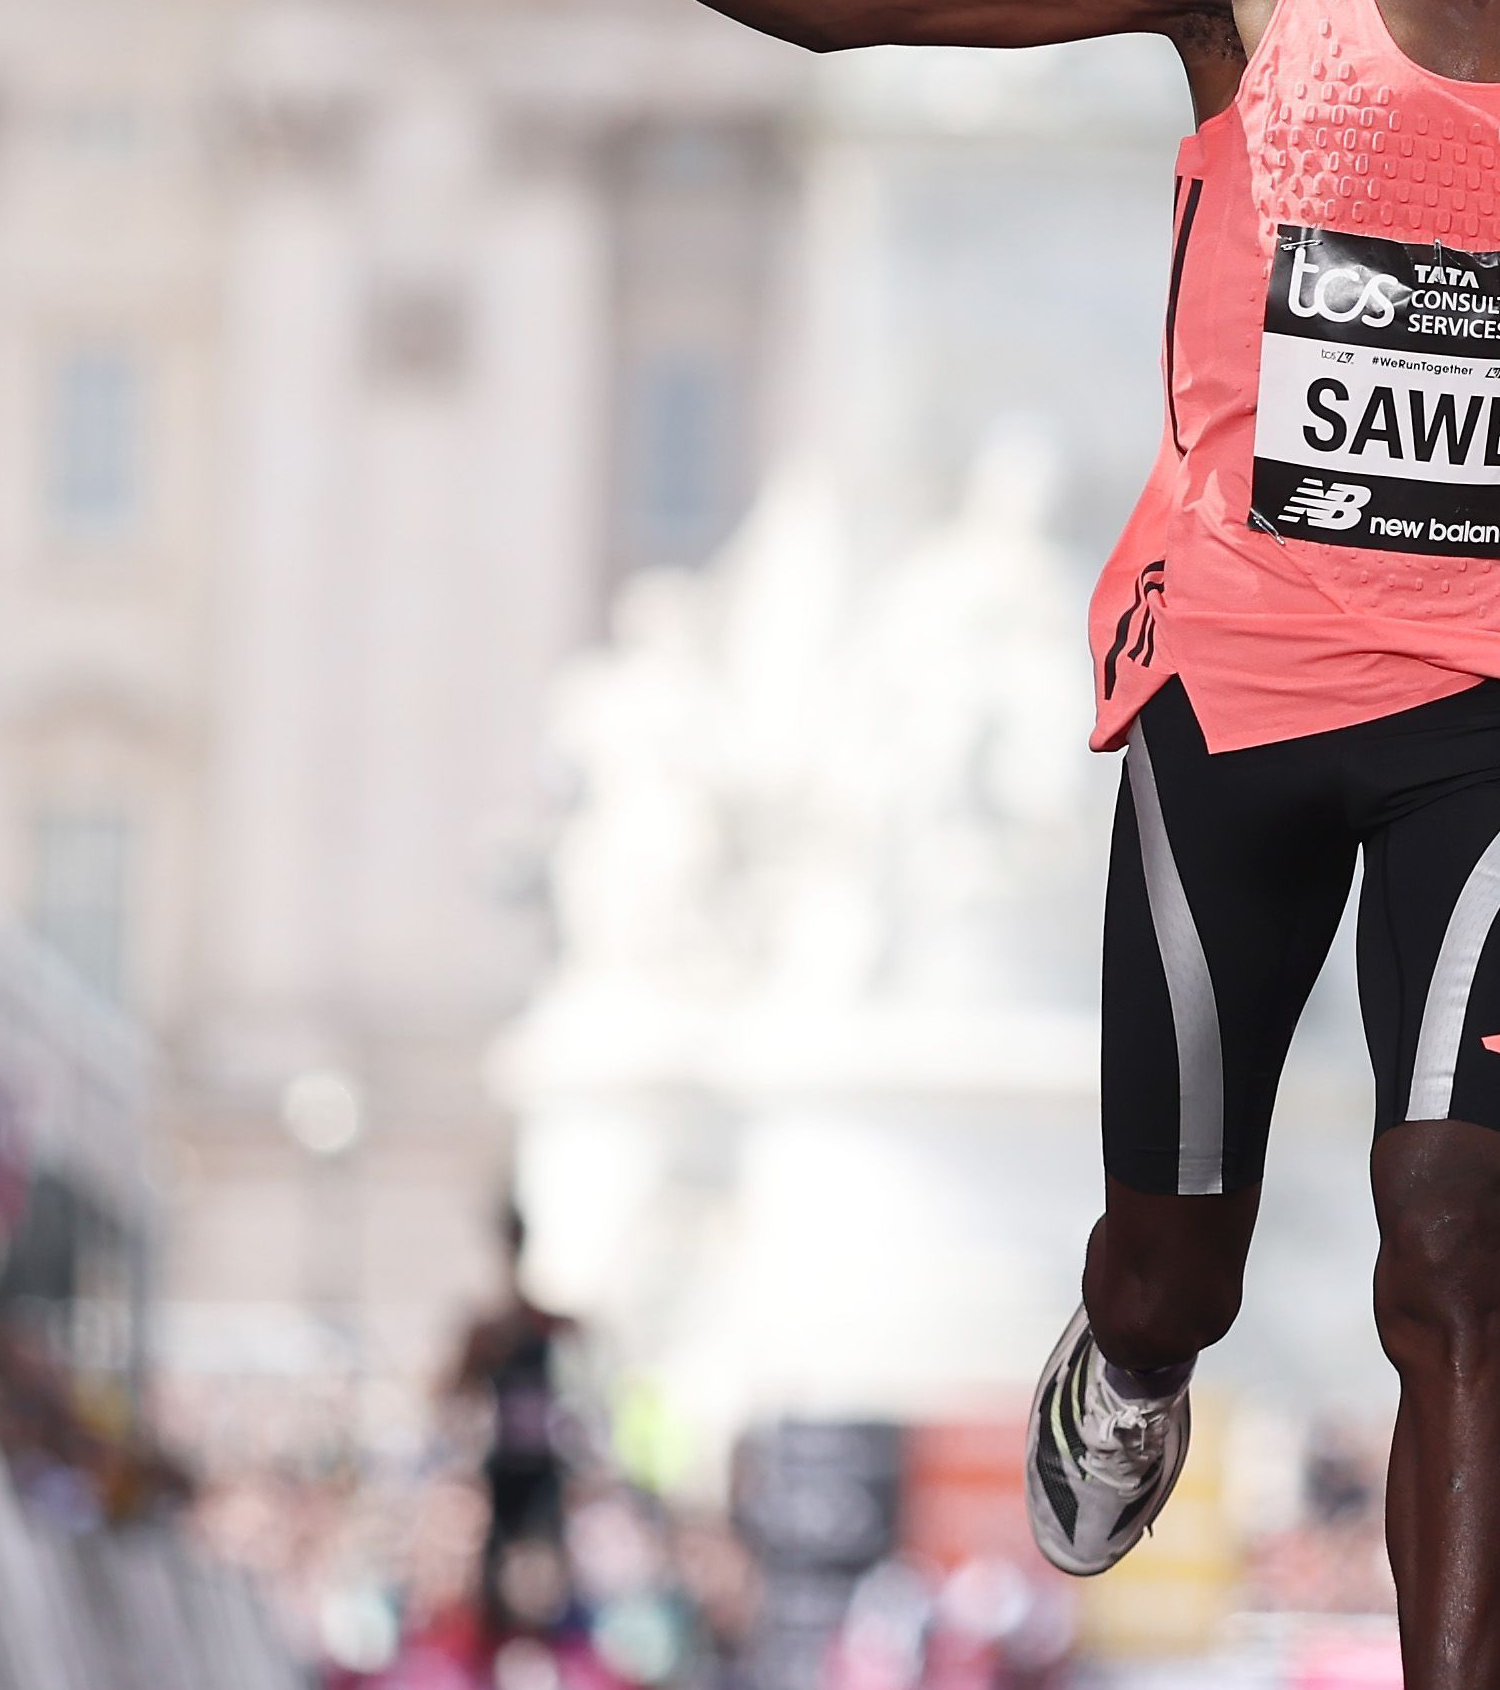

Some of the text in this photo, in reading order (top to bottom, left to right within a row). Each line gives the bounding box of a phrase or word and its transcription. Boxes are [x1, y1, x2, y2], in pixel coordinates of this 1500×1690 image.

[1288, 247, 1398, 328] tcs
[1414, 264, 1480, 289] TATA
[1372, 355, 1474, 376] #WeRunTogether
[1370, 516, 1424, 539] new
